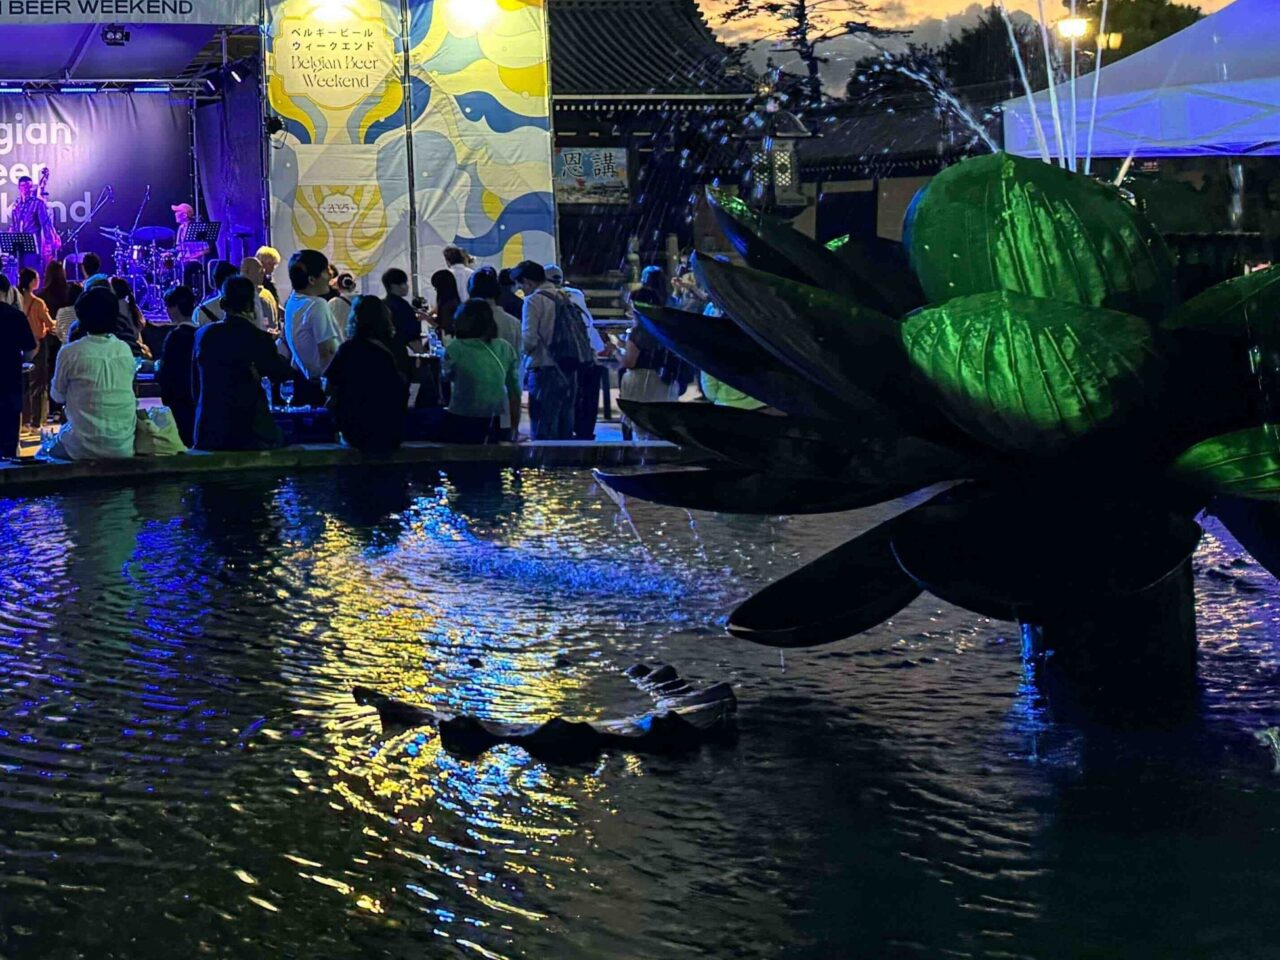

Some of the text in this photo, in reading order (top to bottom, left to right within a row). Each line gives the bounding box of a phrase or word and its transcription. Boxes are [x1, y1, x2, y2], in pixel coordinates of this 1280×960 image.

[9, 0, 71, 15] BEER
[77, 0, 193, 15] WEEKEND
[291, 28, 374, 38] ベルギービール
[292, 41, 375, 51] ウィークエンド
[291, 55, 379, 73] Belgian Beer
[302, 73, 369, 88] Weekend
